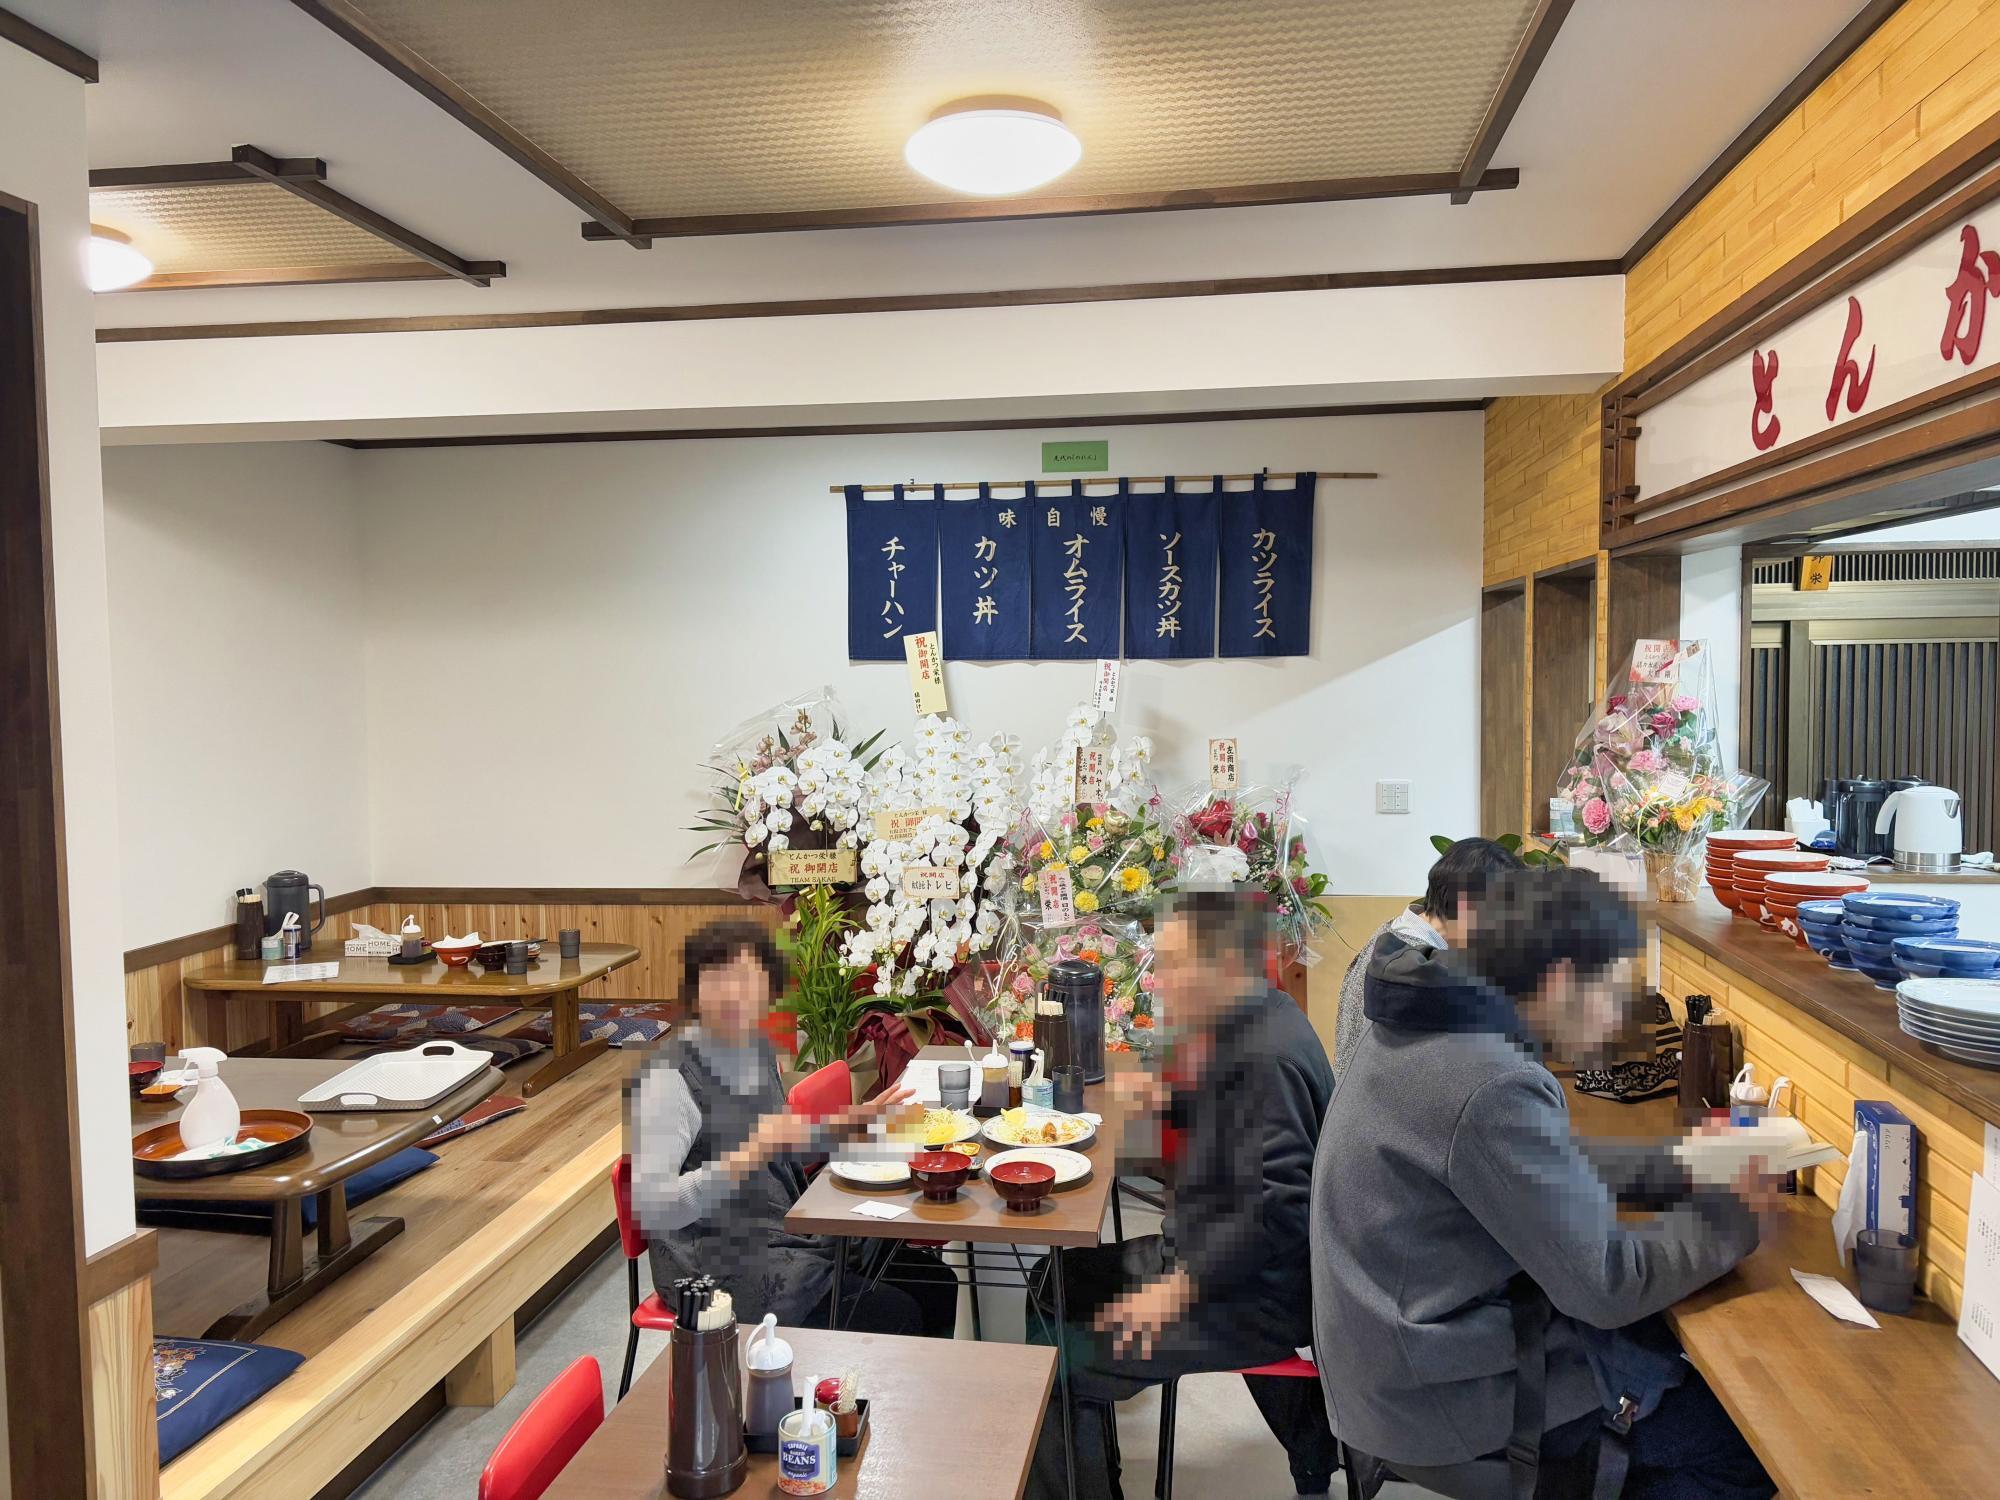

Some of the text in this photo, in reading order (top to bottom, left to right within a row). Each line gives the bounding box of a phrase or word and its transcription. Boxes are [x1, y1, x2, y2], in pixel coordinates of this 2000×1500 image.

[998, 506, 1109, 529] 味自慢
[881, 536, 905, 639] チャーハン
[972, 536, 999, 625] カツ丼
[1063, 534, 1090, 643] オムライス
[1156, 532, 1183, 639] ソースカツ丼
[1252, 528, 1278, 639] カツライス
[915, 636, 930, 680] 祝御開店
[789, 862, 838, 874] 祝 御開店
[920, 871, 945, 879] 祝開店
[783, 1452, 816, 1465] BEANS
